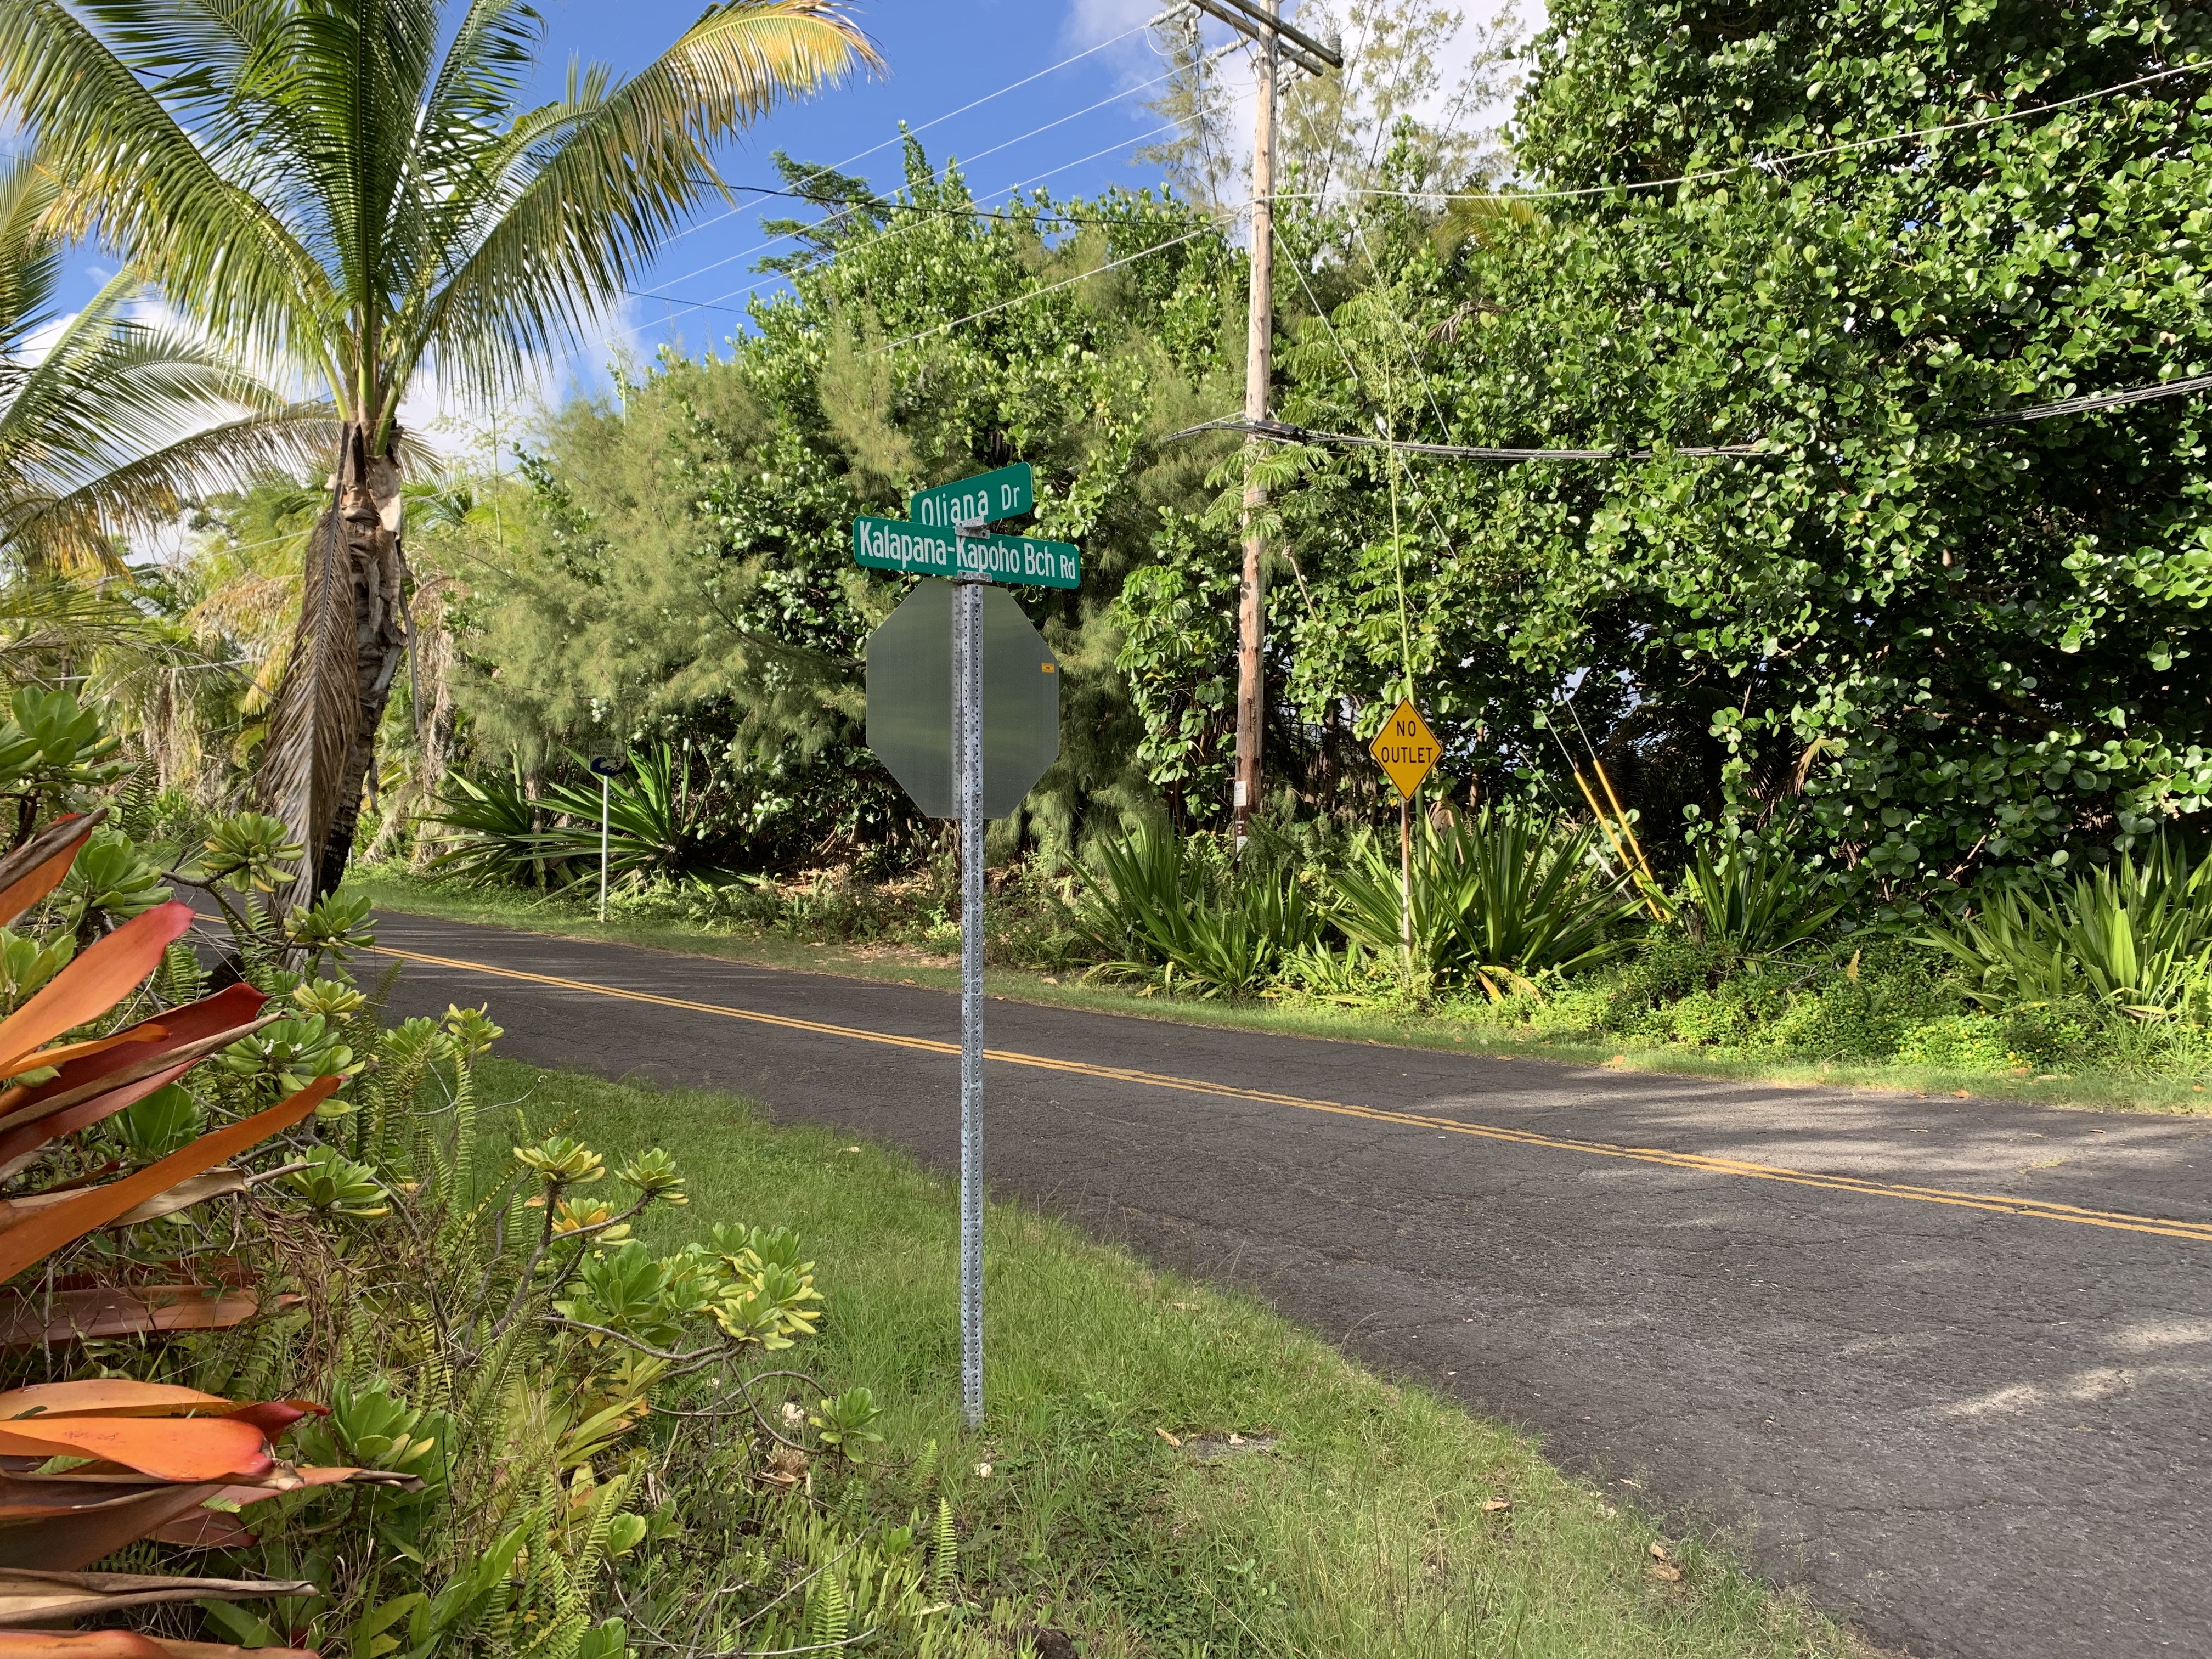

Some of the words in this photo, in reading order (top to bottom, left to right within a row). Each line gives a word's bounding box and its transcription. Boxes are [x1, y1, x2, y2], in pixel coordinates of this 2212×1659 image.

[921, 490, 989, 527] Oliana
[1001, 483, 1020, 511] Dr
[860, 521, 1020, 573] Kalapana-Kapoho
[1024, 543, 1055, 577] Bch
[1059, 554, 1076, 580] Rd
[1396, 720, 1416, 737] NO
[1381, 747, 1433, 763] OUTLET
